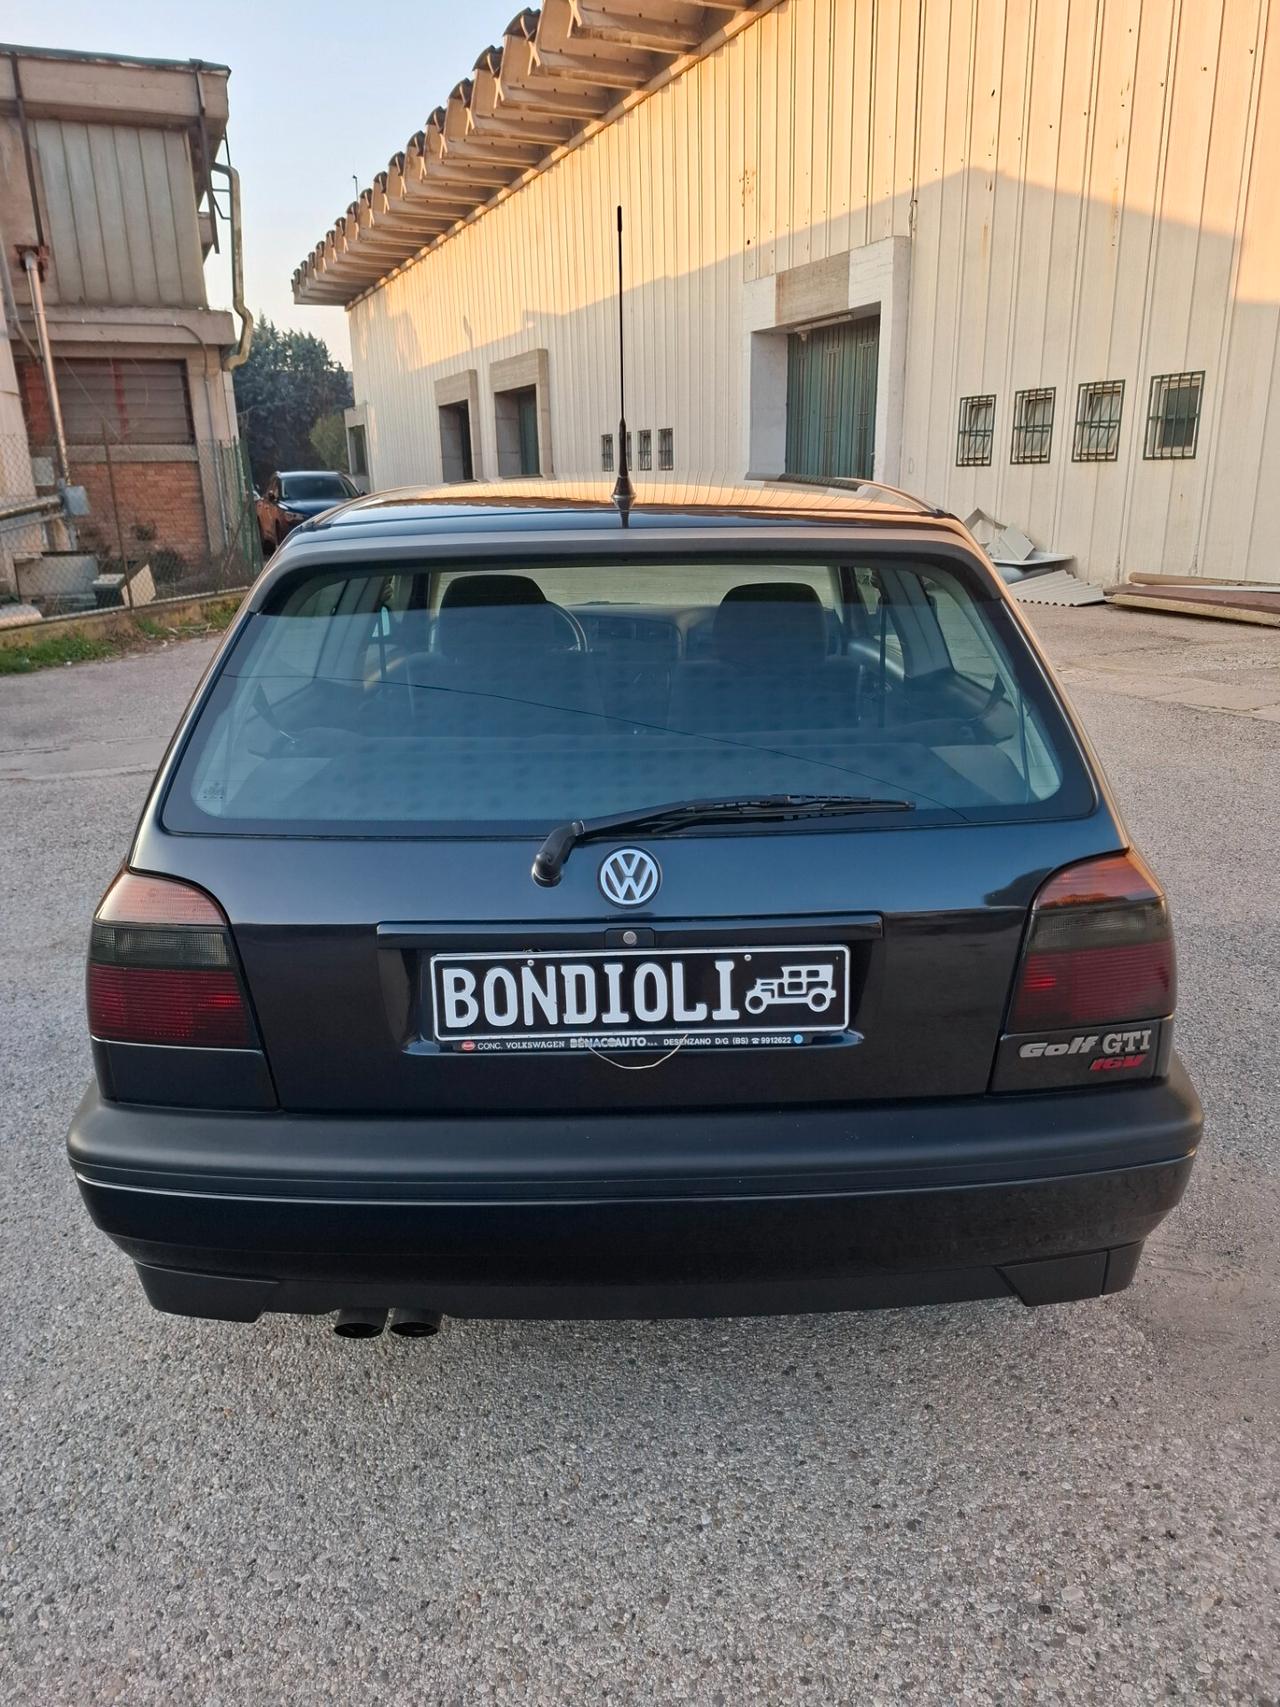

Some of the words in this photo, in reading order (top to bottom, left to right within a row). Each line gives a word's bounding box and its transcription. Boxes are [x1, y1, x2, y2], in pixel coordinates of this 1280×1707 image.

[442, 960, 740, 1028] BONDIOLI
[506, 1040, 565, 1049] VOLKSWAGEN
[663, 1038, 712, 1046] DESENZANO
[732, 1036, 749, 1045] (BS)
[760, 1036, 792, 1045] 9912622
[1020, 1036, 1099, 1058] Golf
[1102, 1030, 1151, 1054] GTI
